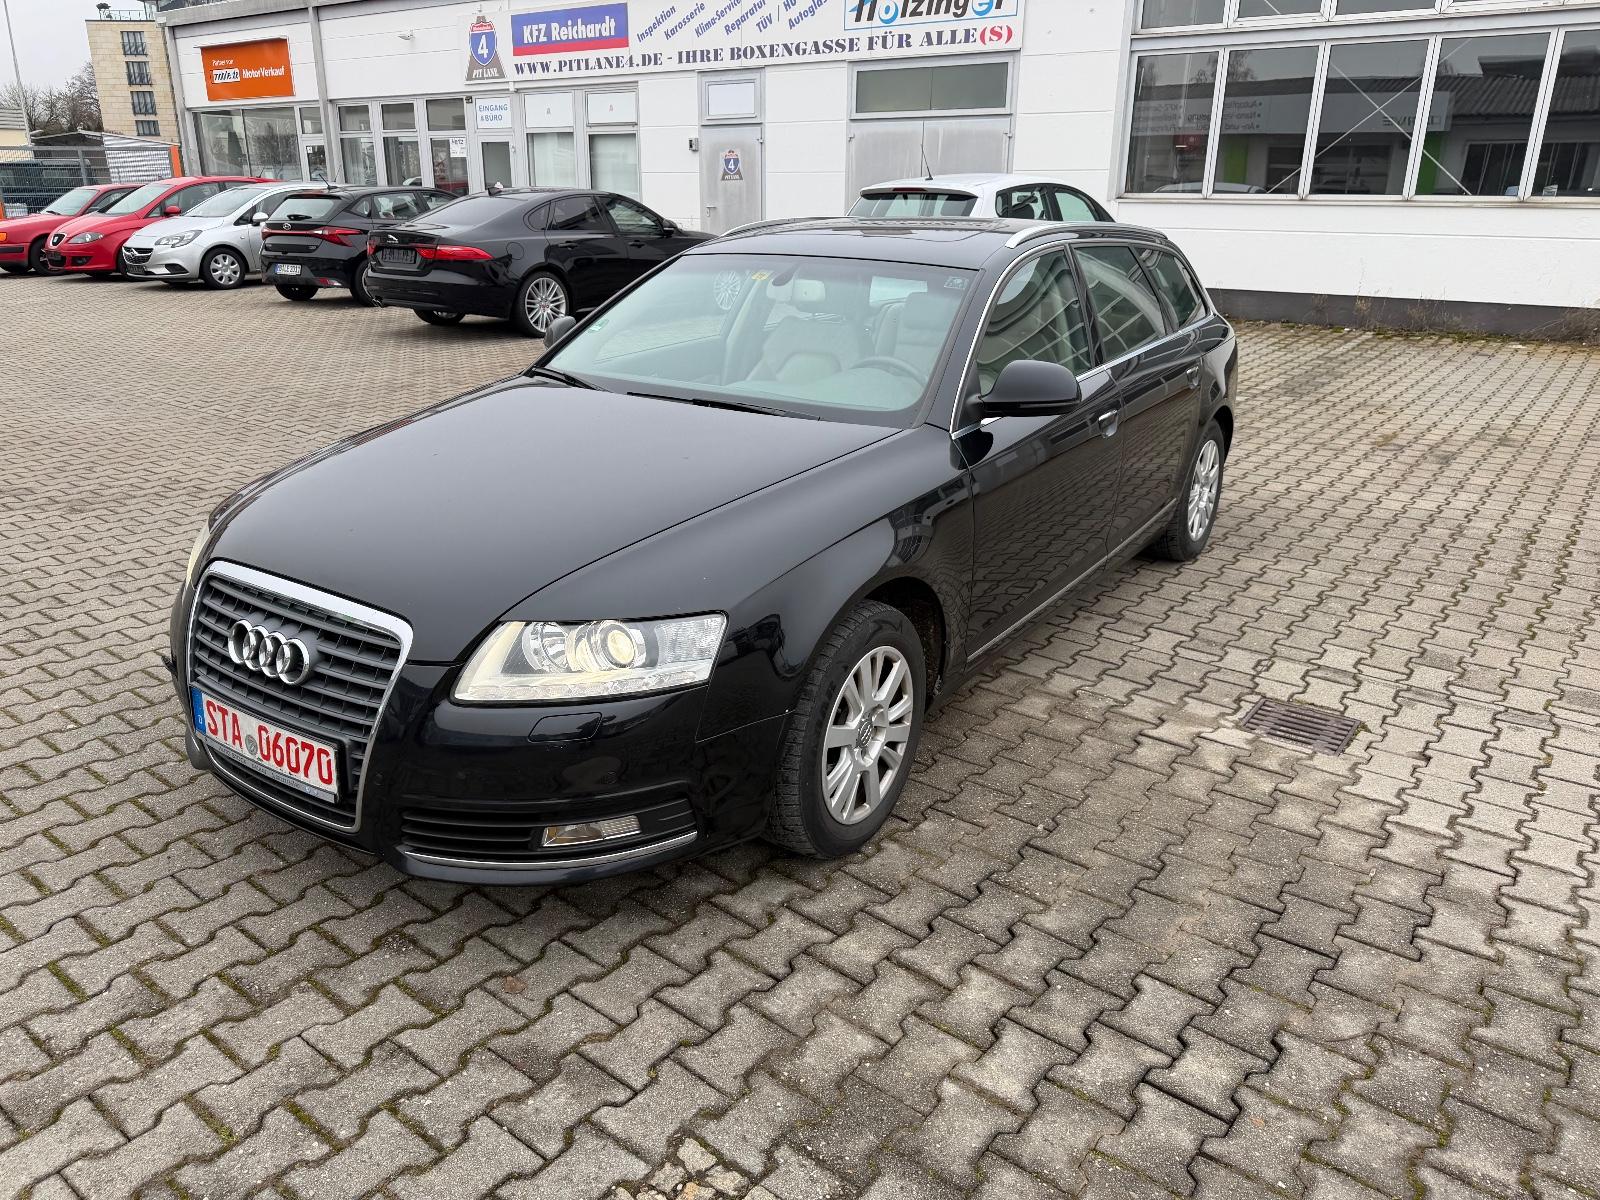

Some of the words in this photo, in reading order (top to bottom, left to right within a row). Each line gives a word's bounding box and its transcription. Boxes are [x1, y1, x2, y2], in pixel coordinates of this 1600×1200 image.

[522, 23, 548, 44] KFZ
[551, 15, 616, 41] Reichardt
[636, 5, 677, 43] Inspektion
[663, 2, 706, 41] Karosserie
[755, 12, 773, 33] TÜV
[477, 34, 489, 59] 4
[514, 52, 663, 75] WWW.PITLANE4.DE
[677, 47, 724, 64] IHRE
[729, 37, 860, 61] BOXENGASSE
[867, 30, 912, 50] FÜR
[919, 24, 1013, 47] ALLE(S)
[472, 68, 484, 79] PIT
[478, 103, 508, 112] EINGANG
[727, 158, 735, 171] 4
[205, 699, 243, 749] STA
[257, 724, 334, 785] 06070
